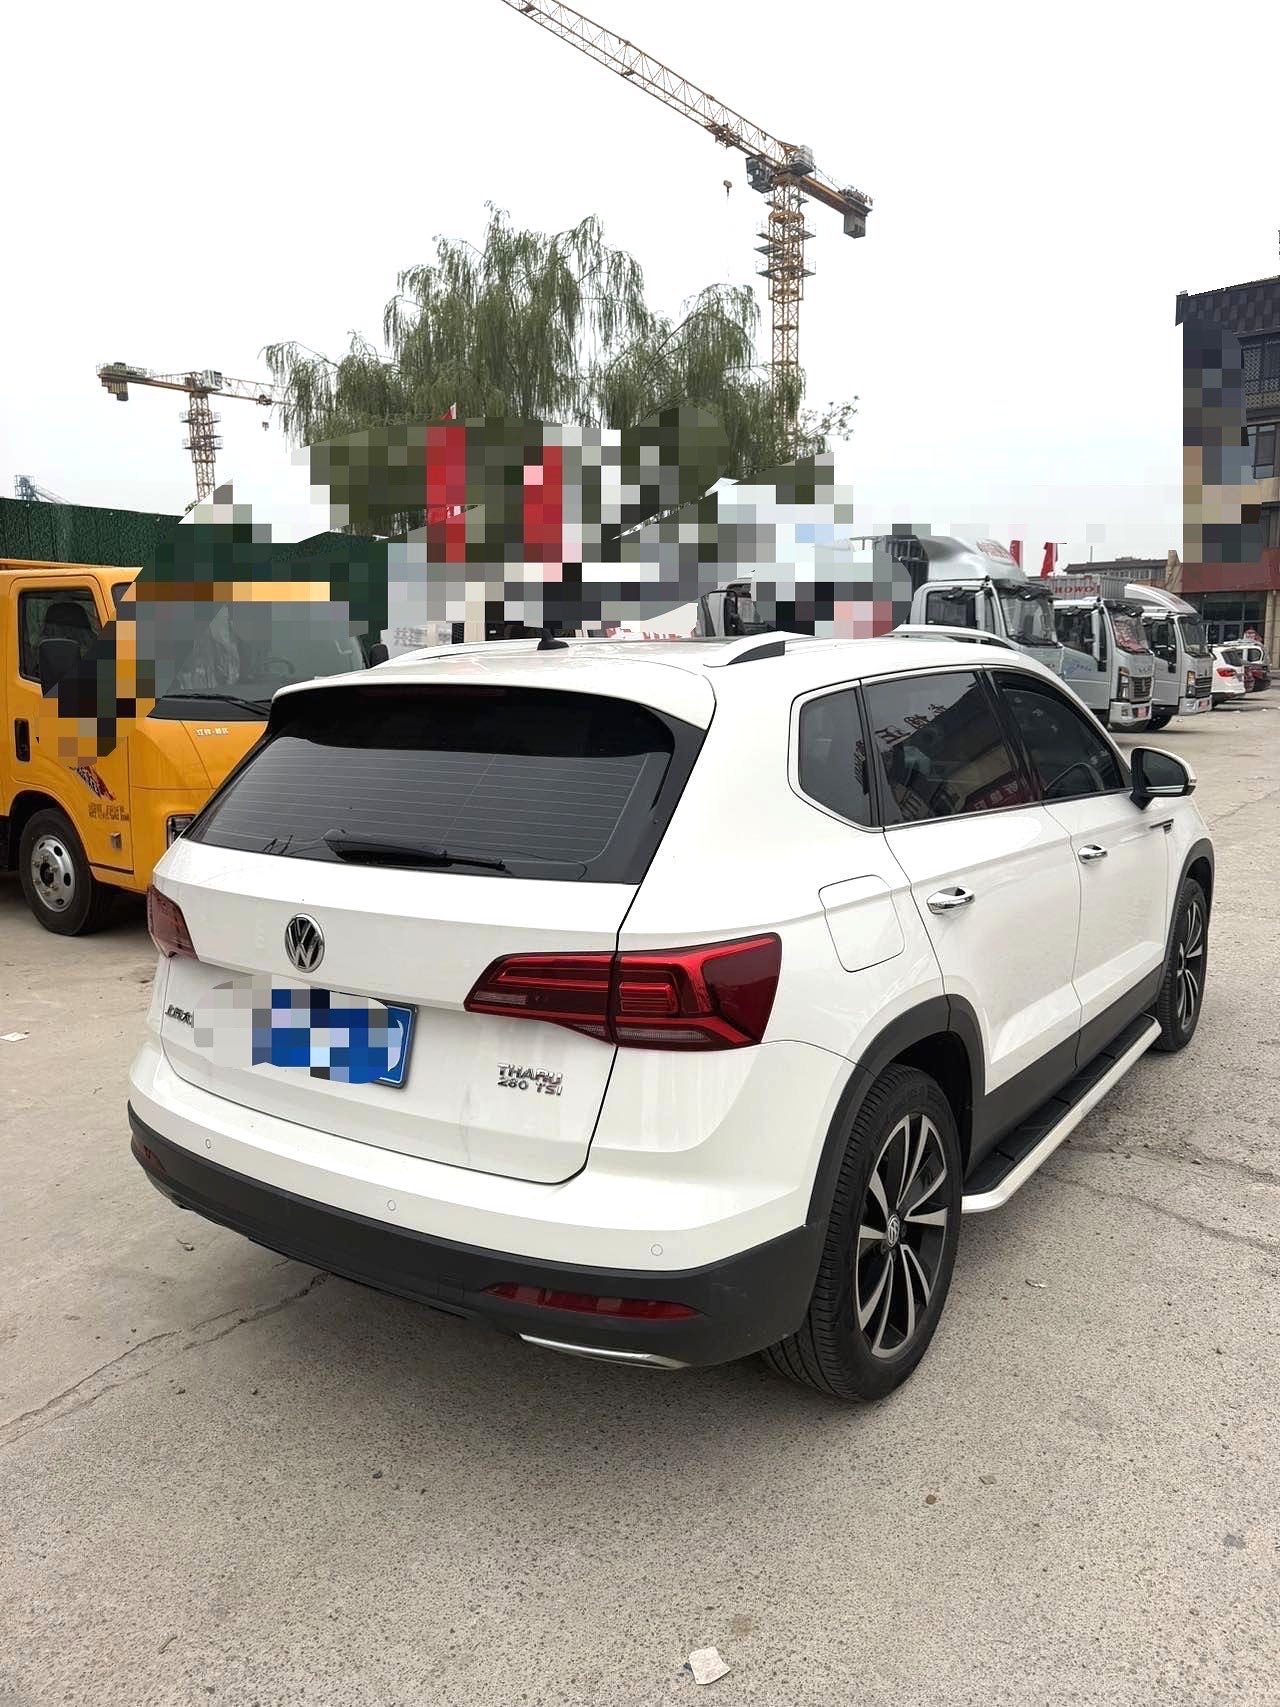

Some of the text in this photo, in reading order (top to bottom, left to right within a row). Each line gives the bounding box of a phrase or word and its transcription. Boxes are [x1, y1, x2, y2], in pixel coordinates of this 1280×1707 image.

[497, 1063, 563, 1085] THARU
[497, 1077, 563, 1096] 280 TSI
